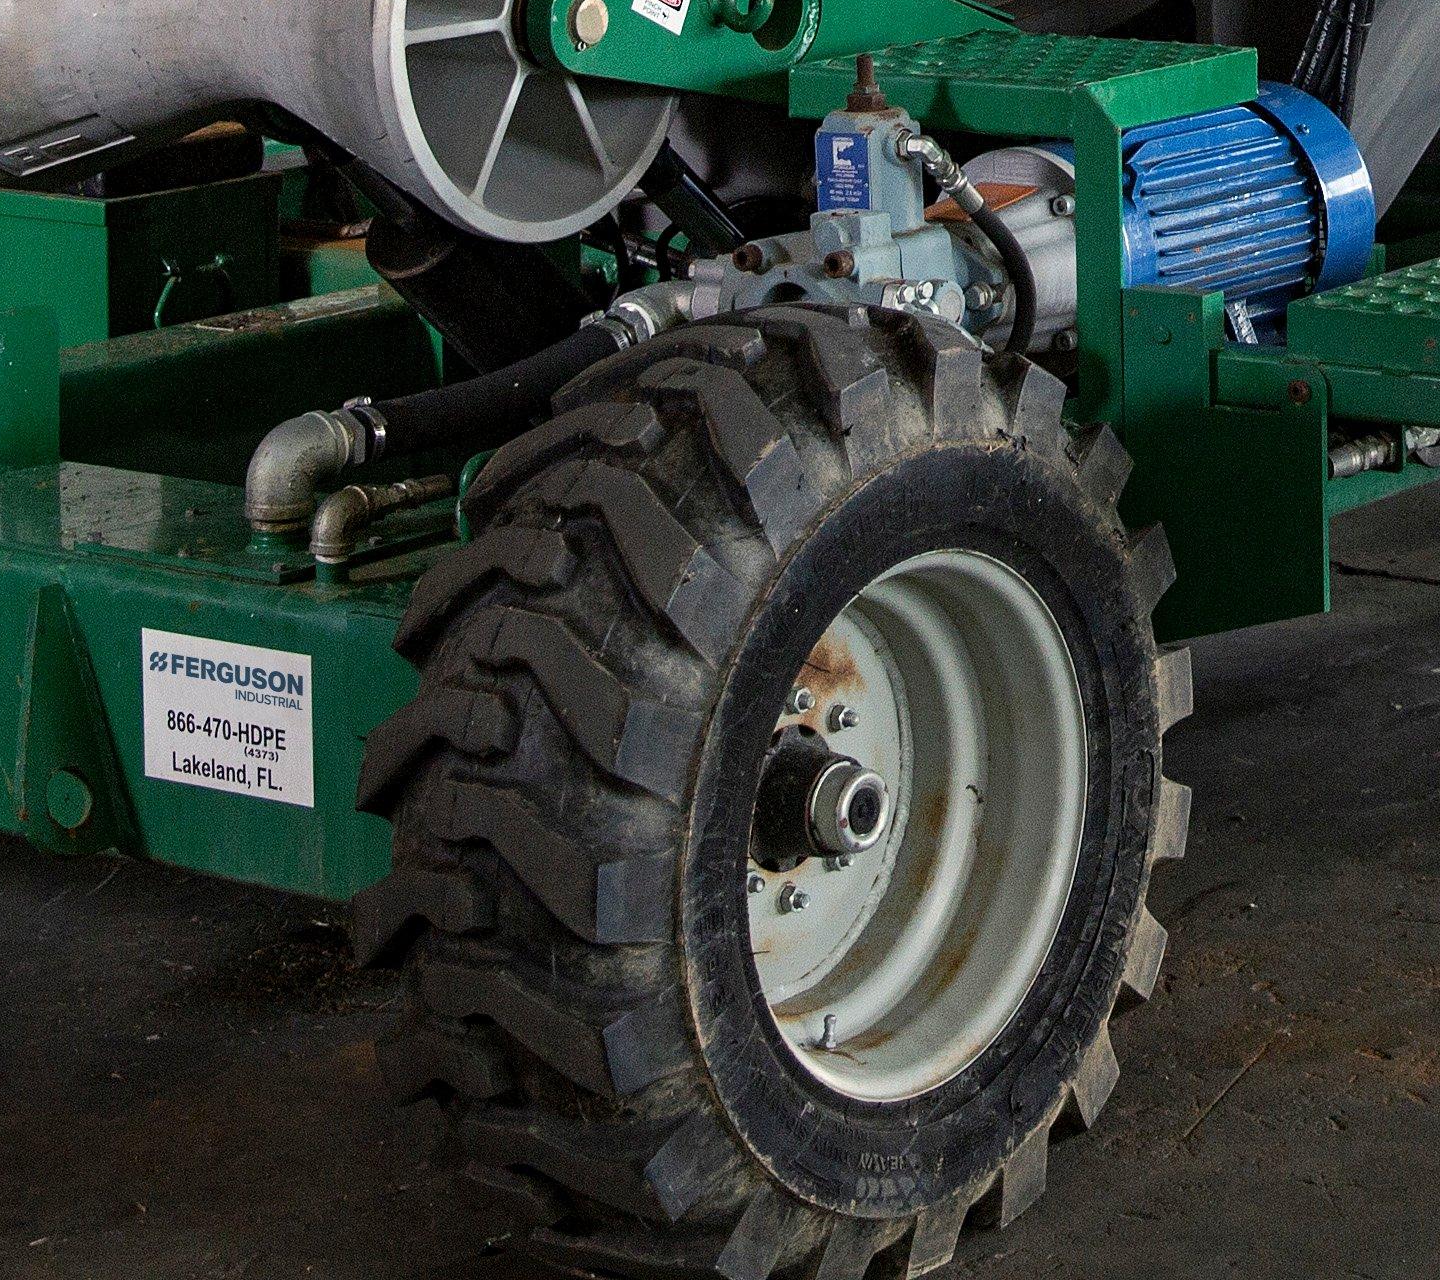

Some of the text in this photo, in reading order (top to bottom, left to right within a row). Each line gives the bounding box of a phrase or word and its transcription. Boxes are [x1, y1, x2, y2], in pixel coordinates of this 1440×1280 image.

[171, 653, 304, 696] FERGUSON
[234, 689, 303, 711] INDUSTRIAL
[167, 709, 287, 751] 866-470-HDPE
[172, 751, 283, 791] Lakeland, FL.
[244, 746, 279, 763] (4373)
